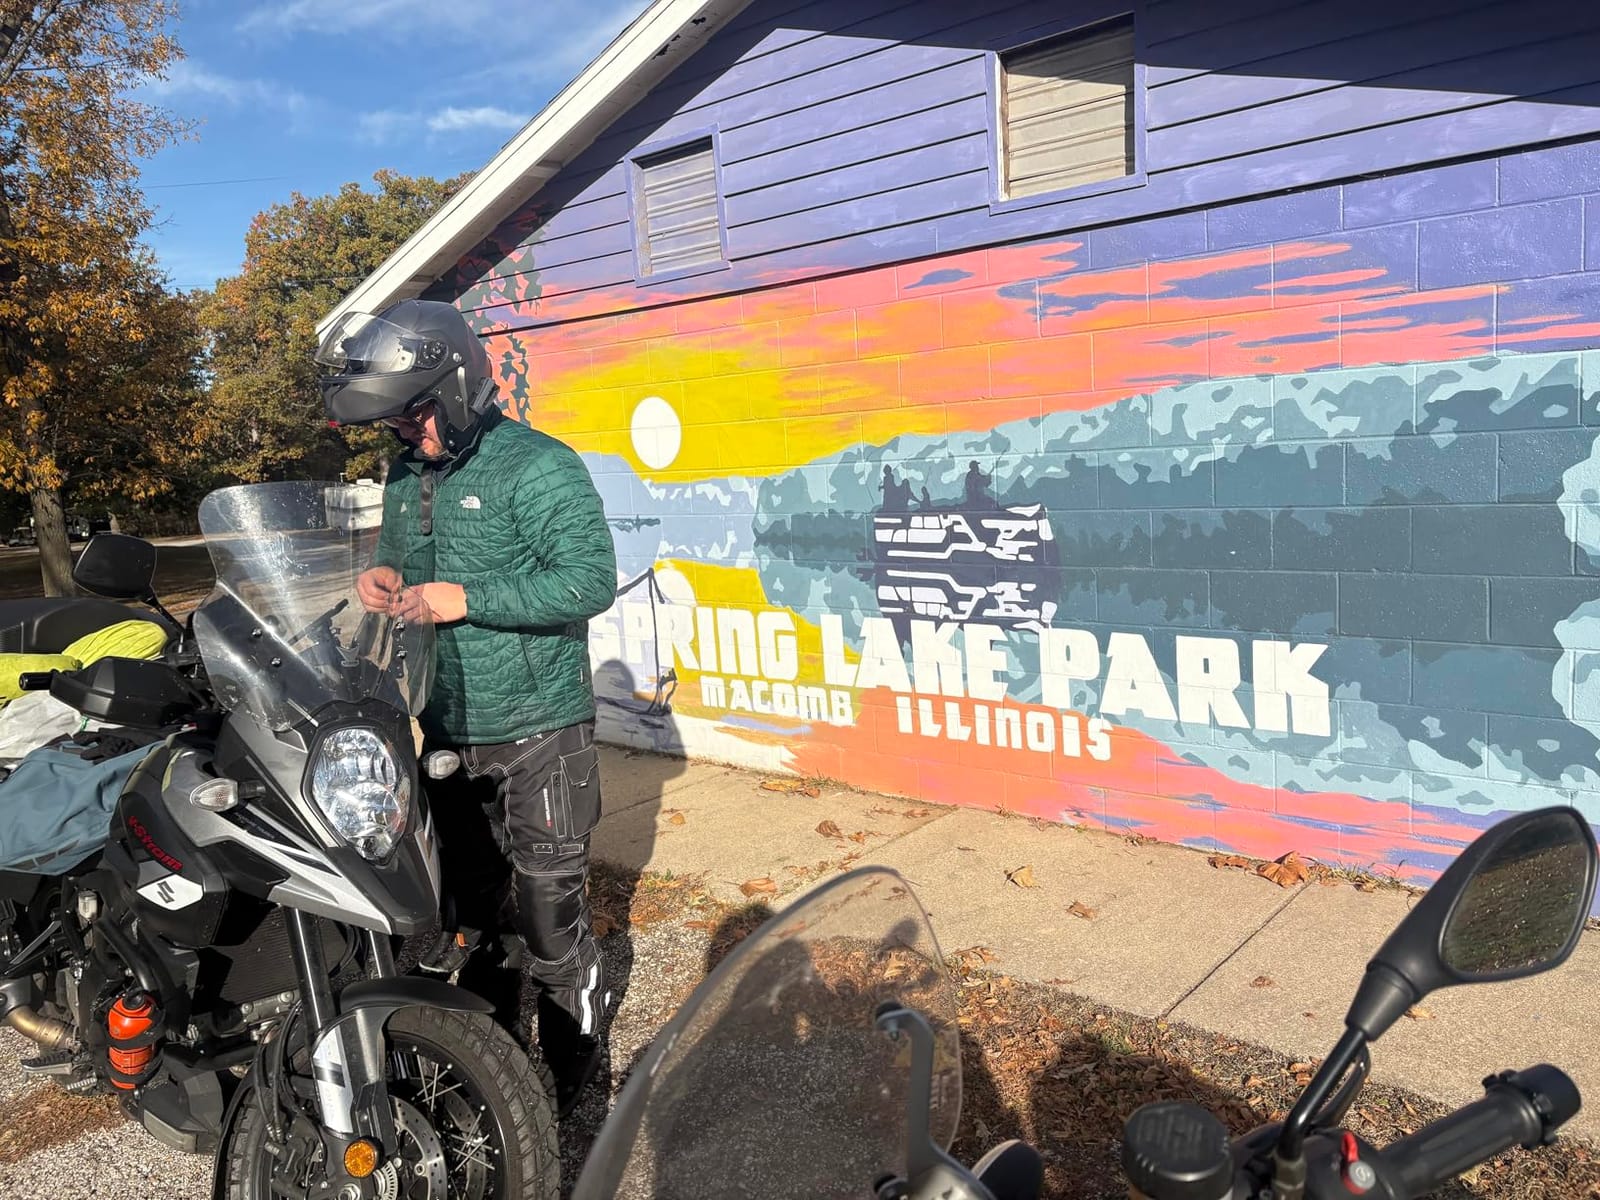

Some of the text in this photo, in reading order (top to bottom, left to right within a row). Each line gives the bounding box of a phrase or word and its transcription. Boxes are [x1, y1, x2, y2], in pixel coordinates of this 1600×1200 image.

[588, 600, 1331, 737] SPRING LAKE PARK
[699, 675, 856, 727] MACOMB
[896, 695, 1113, 761] ILLINOIS
